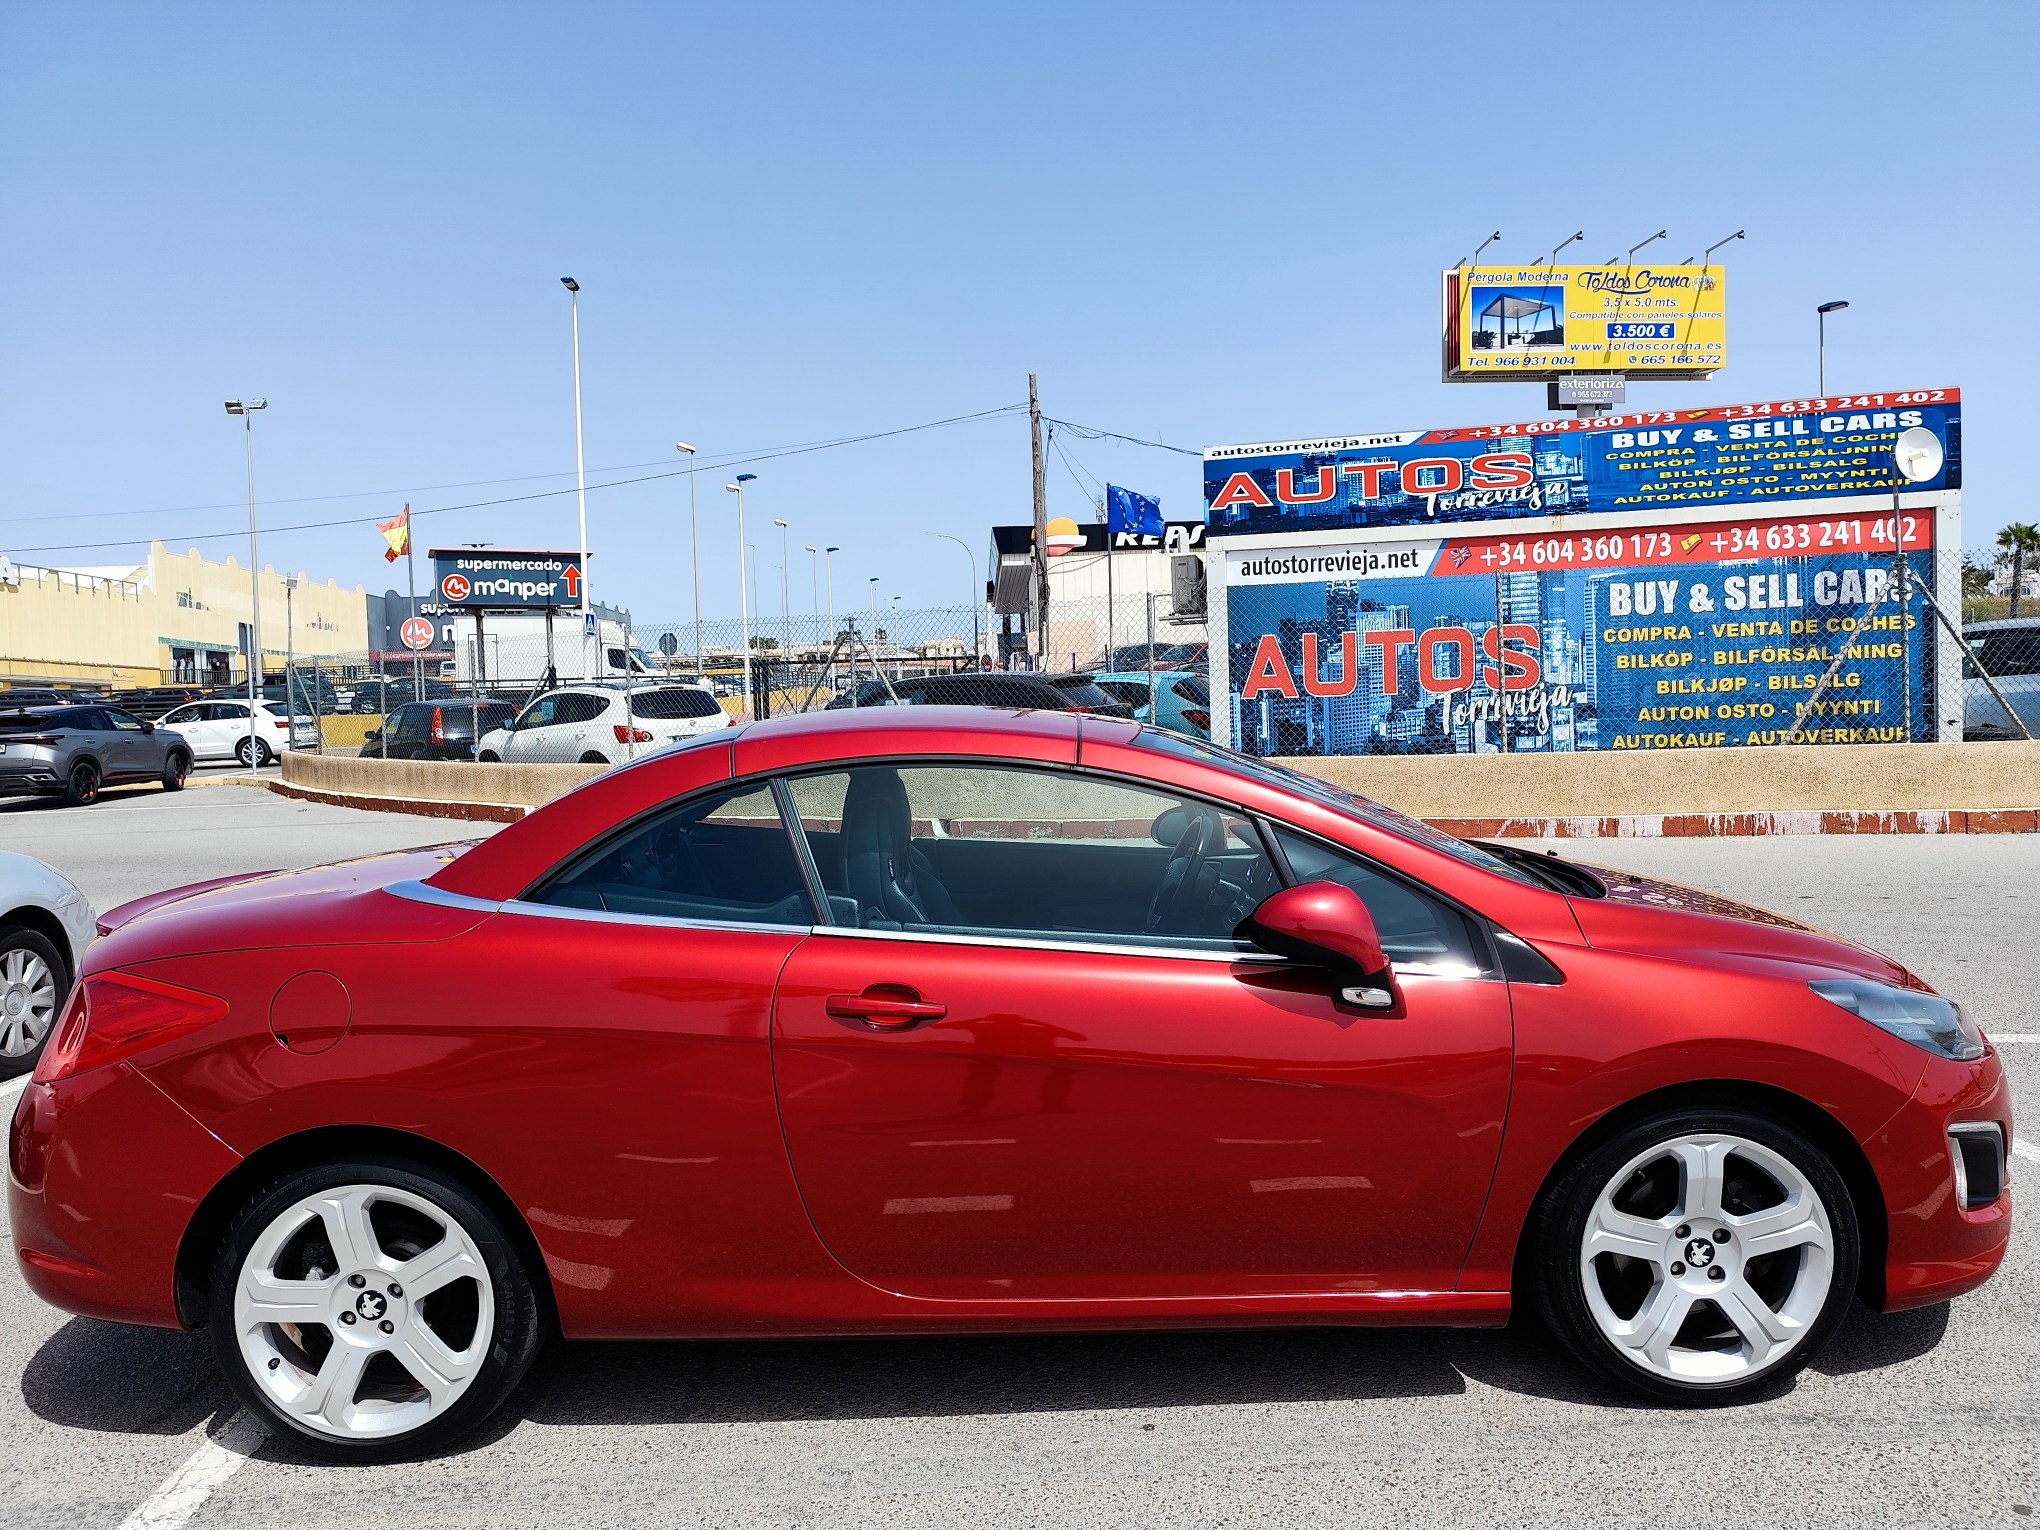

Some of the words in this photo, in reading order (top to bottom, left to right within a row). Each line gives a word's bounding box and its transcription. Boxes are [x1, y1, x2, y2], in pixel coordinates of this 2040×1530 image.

[1467, 272, 1512, 284] Pérgola
[1517, 271, 1569, 282] Moderna
[1635, 270, 1691, 289] Corona
[1604, 298, 1621, 308] 3,5
[1624, 299, 1631, 307] x
[1634, 297, 1652, 308] 5,0
[1655, 298, 1679, 307] mts.
[1569, 311, 1623, 319] Compatible
[1647, 311, 1684, 319] paneles
[1687, 311, 1722, 319] solares
[1612, 325, 1656, 337] 3.500
[1659, 325, 1671, 337] €
[1570, 341, 1722, 351] www.toldoscorona.es
[1467, 357, 1491, 367] Tel.
[1495, 357, 1520, 366] 966
[1523, 356, 1547, 366] 931
[1551, 356, 1576, 365] 004
[1641, 355, 1666, 364] 665
[1671, 355, 1693, 364] 166
[1696, 355, 1721, 364] 572
[1559, 377, 1625, 389] exterioriza
[1719, 404, 1772, 417] +34
[1780, 400, 1828, 413] 633
[1837, 395, 1884, 409] 241
[1894, 390, 1945, 403] 402
[1469, 425, 1519, 438] +34
[1525, 420, 1571, 433] 604
[1578, 416, 1624, 430] 360
[1631, 412, 1677, 425] 173
[1612, 428, 1683, 449] BUY
[1692, 429, 1718, 442] &
[1728, 419, 1810, 440] SELL
[1820, 410, 1923, 433] CARS
[1211, 434, 1403, 457] autostorrevieja.net
[1605, 447, 1695, 460] COMPRA
[1716, 441, 1788, 452] VENTA
[1796, 438, 1825, 446] DE
[1619, 458, 1697, 470] BILKÖP
[1659, 466, 1752, 479] BILKJØP
[1773, 457, 1868, 471] BILSALG
[1209, 452, 1534, 510] AUTOS
[1613, 490, 1730, 504] AUTOKAUF
[1750, 478, 1915, 495] AUTOVERKAUF
[1640, 480, 1714, 492] AUTON
[1720, 476, 1780, 486] OSTO
[1801, 468, 1888, 480] MYYNTI
[1419, 482, 1567, 516] Torrevieja
[1710, 526, 1760, 553] +34
[1766, 523, 1811, 550] 633
[1818, 519, 1861, 547] 241
[1870, 516, 1917, 544] 402
[1480, 541, 1526, 566] +34
[1532, 538, 1575, 564] 604
[1580, 535, 1623, 562] 360
[1630, 532, 1672, 559] 173
[456, 558, 562, 572] supermercado
[1241, 549, 1419, 576] autostorrevieja.net
[474, 578, 557, 600] manper
[1609, 579, 1680, 616] BUY
[1688, 583, 1715, 613] &
[1724, 573, 1804, 611] SELL
[1603, 626, 1692, 643] COMPRA
[1711, 621, 1783, 638] VENTA
[1790, 619, 1819, 634] DE
[1241, 623, 1541, 699] AUTOS
[1616, 650, 1694, 669] BILKÖP
[1656, 677, 1748, 694] BILKJØP
[1638, 705, 1710, 722] AUTON
[1717, 703, 1775, 719] OSTO
[1795, 699, 1881, 716] MYYNTI
[1613, 732, 1726, 749] AUTOKAUF
